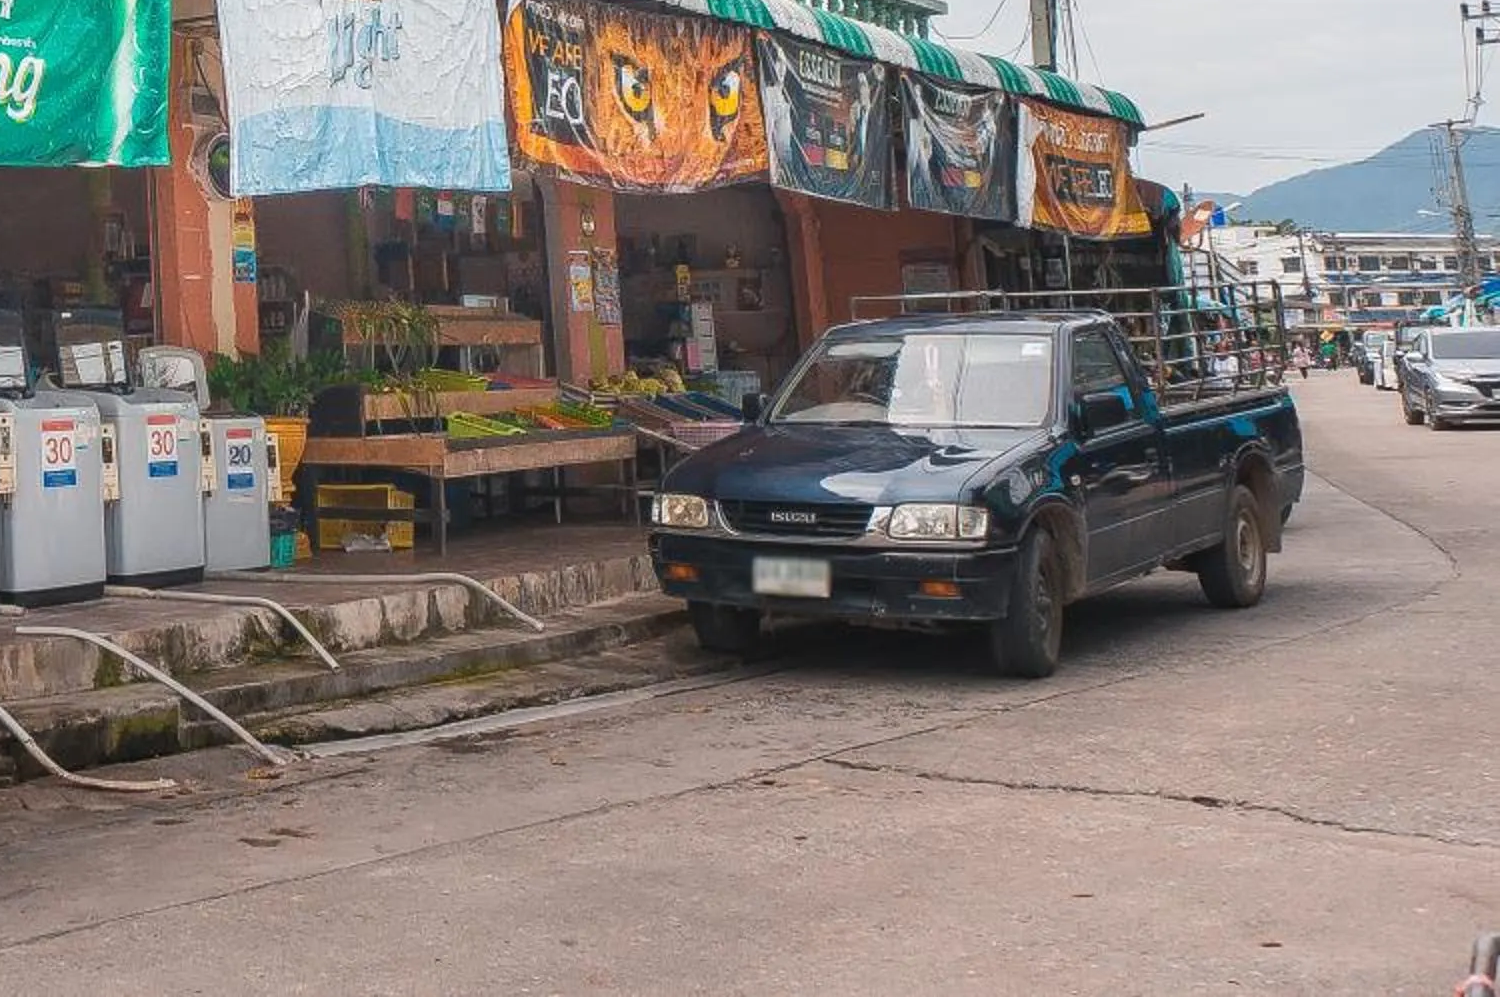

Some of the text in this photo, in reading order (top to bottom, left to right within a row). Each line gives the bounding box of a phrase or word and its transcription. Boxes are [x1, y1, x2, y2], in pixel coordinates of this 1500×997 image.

[45, 437, 72, 464] 30
[151, 430, 175, 456] 30
[229, 444, 252, 466] 20
[771, 512, 817, 523] ISUZU
